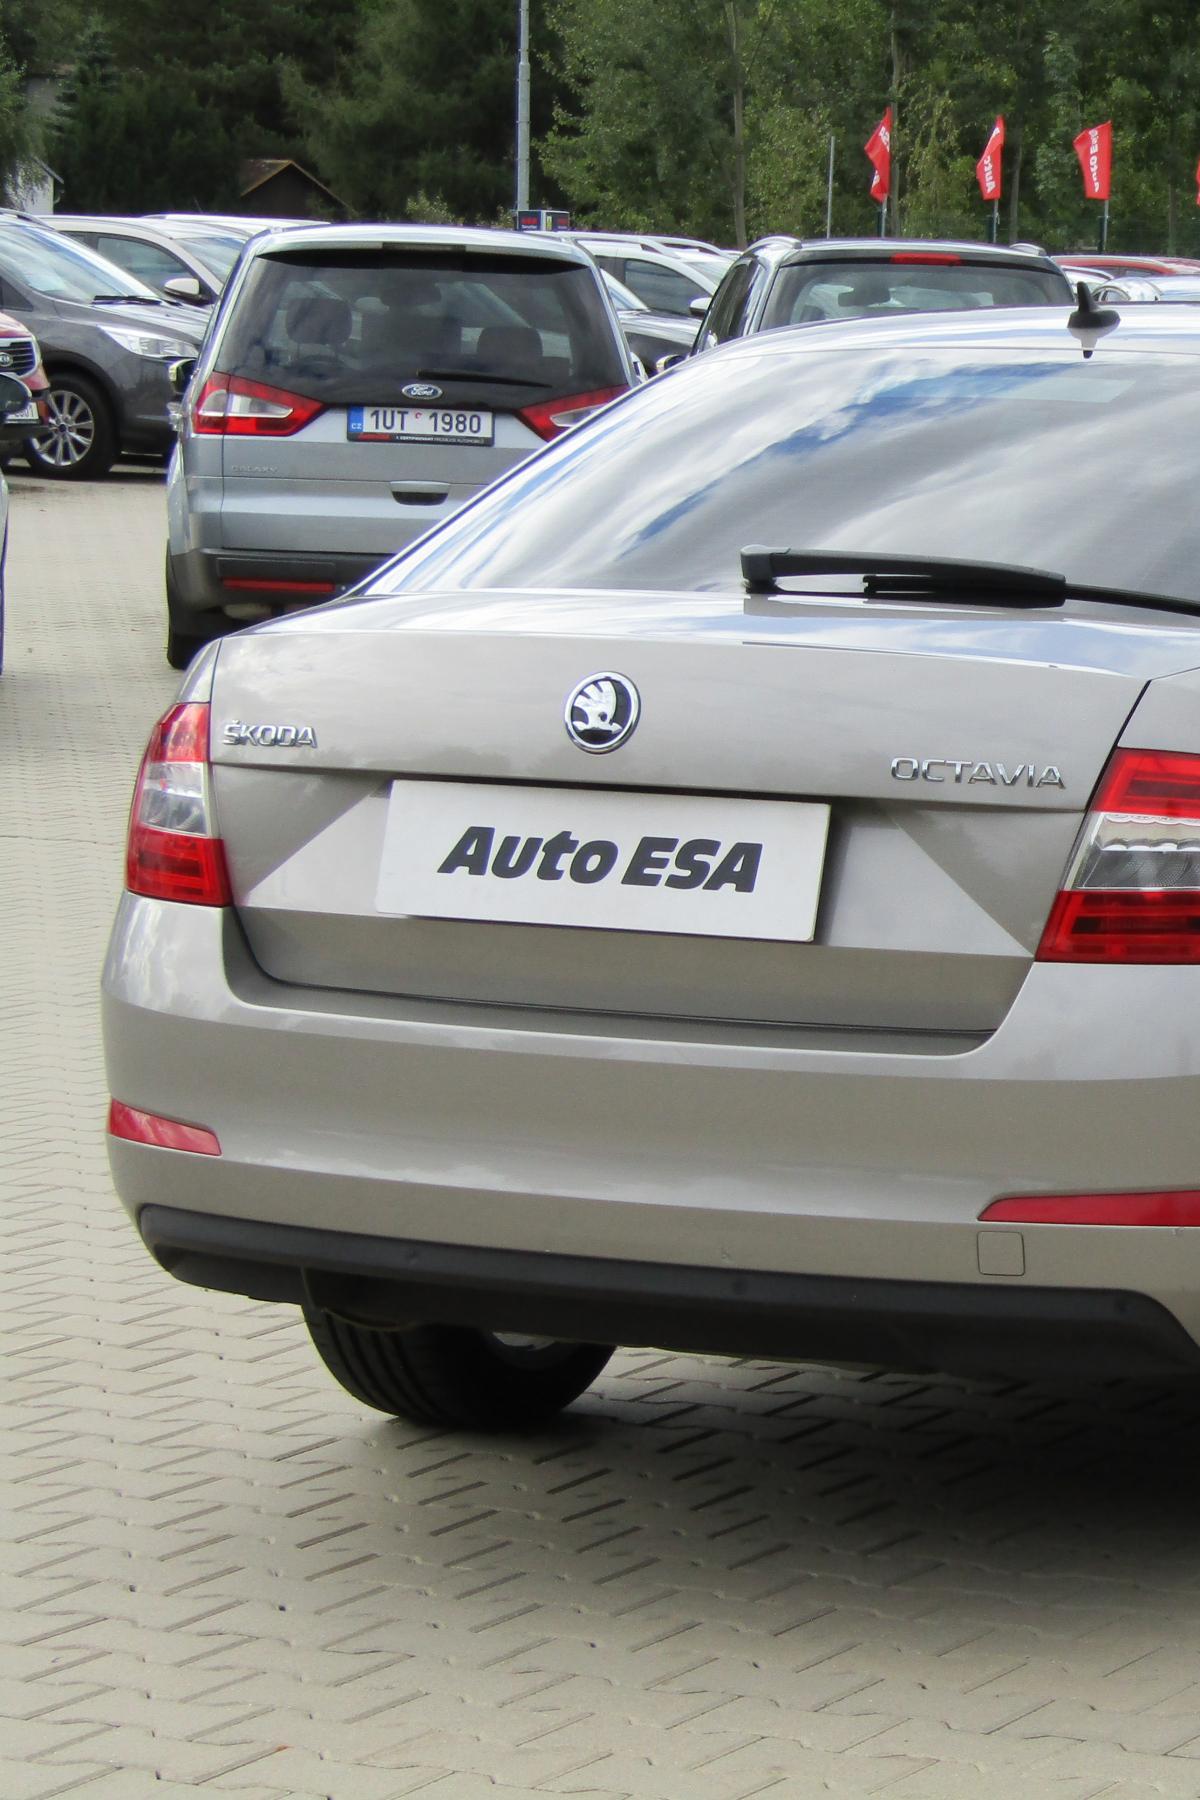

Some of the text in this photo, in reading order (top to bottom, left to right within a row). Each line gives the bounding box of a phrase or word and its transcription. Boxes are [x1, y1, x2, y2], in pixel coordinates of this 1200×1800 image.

[410, 384, 434, 396] Ford
[370, 409, 481, 434] 1UT 1980
[223, 719, 318, 748] ŠKODA
[890, 757, 1066, 790] OCTAVIA
[437, 826, 764, 893] Auto ESA
